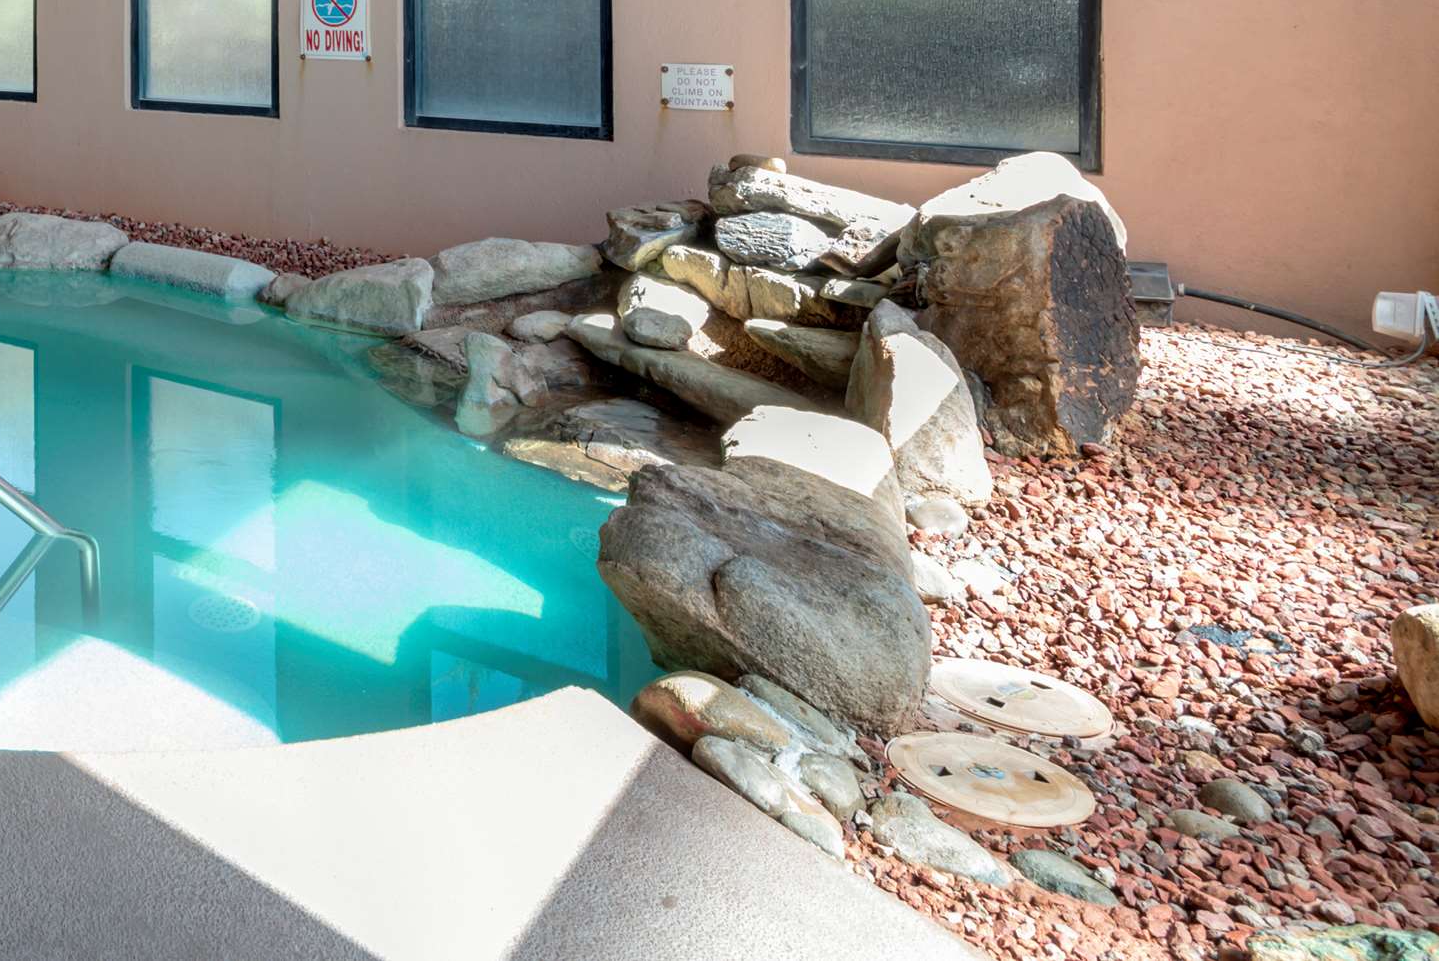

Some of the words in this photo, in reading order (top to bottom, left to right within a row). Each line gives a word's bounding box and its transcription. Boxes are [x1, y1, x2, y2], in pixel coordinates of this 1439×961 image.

[306, 30, 320, 51] NO
[325, 30, 364, 52] DIVING!
[676, 67, 720, 76] PLEASE
[677, 77, 690, 86] DO
[696, 78, 717, 86] NOT
[672, 87, 704, 96] CLIMB
[708, 89, 722, 97] ON
[668, 96, 728, 108] FOUNTAINS
